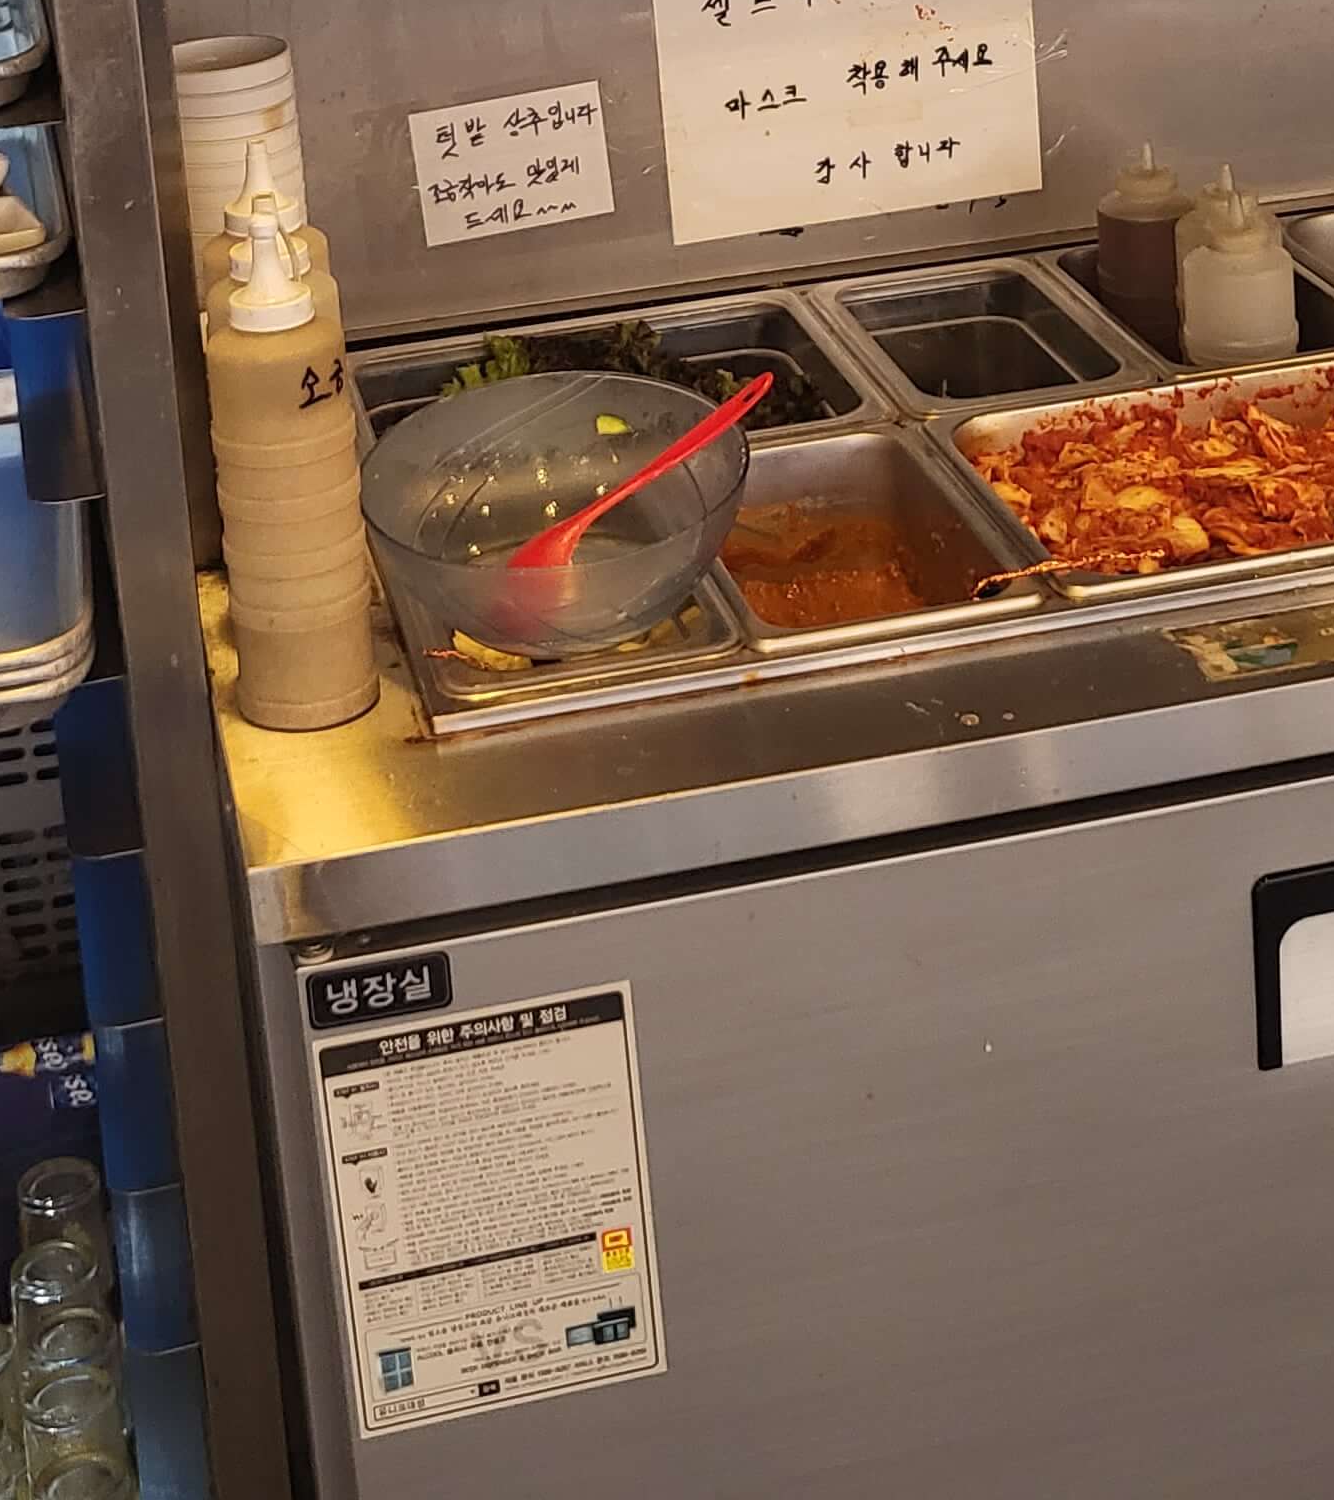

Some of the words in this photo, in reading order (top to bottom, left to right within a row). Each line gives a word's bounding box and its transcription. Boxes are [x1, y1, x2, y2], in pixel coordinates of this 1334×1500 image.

[502, 100, 599, 137] 상추입니다
[724, 83, 808, 120] 마스크
[325, 964, 434, 1016] 냉장실
[379, 1033, 422, 1057] 안전을
[426, 1028, 455, 1047] 위한
[459, 1015, 515, 1040] 주의사항
[518, 1010, 534, 1029] 및
[538, 1004, 568, 1025] 점검
